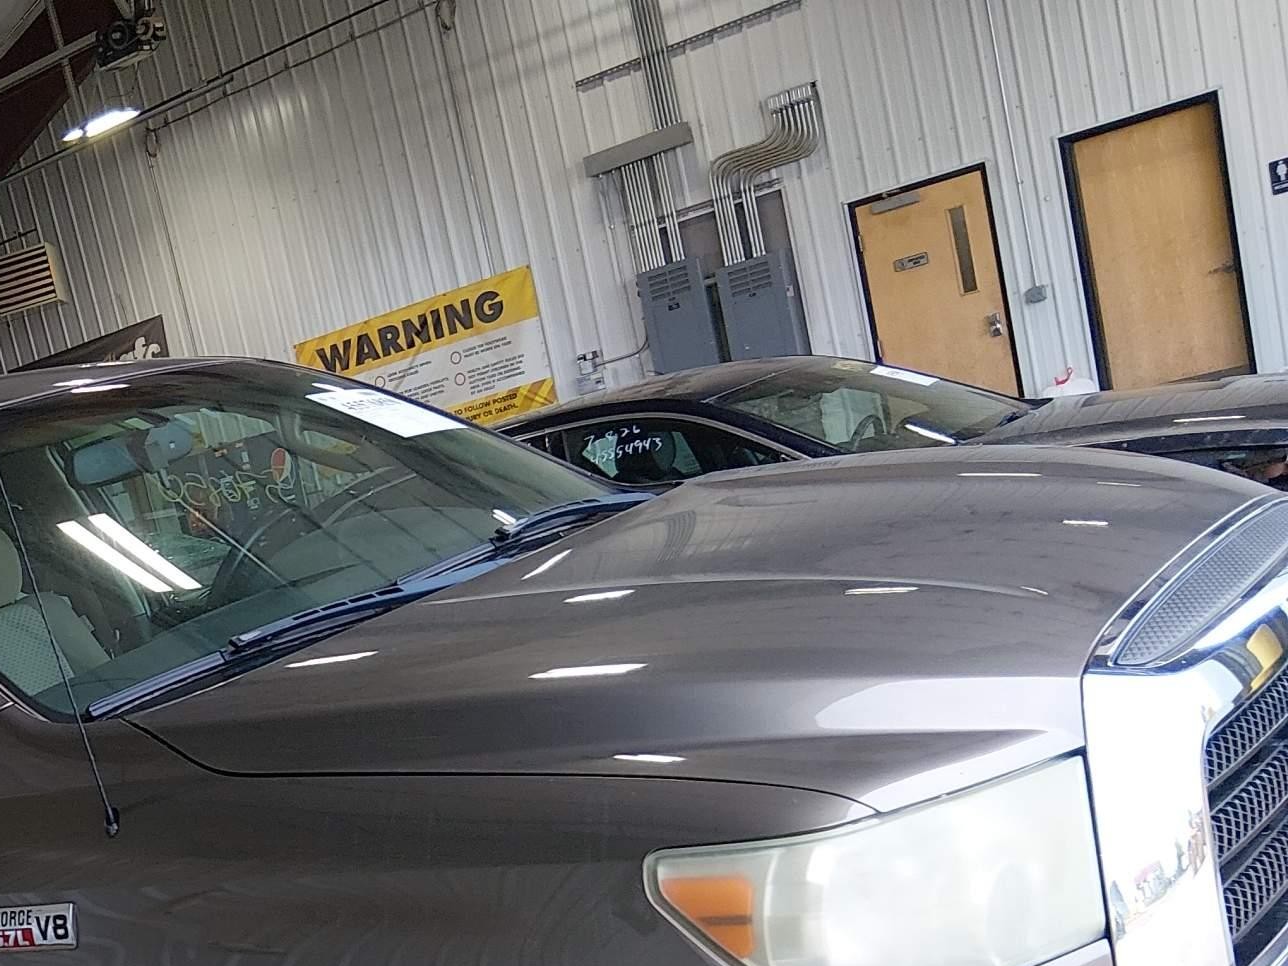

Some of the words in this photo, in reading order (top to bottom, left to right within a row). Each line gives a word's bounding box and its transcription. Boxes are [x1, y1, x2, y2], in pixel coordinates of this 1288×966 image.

[316, 290, 504, 373] WARNING
[464, 400, 491, 413] FOLLOW
[492, 393, 518, 405] POSTED
[34, 914, 69, 941] V8
